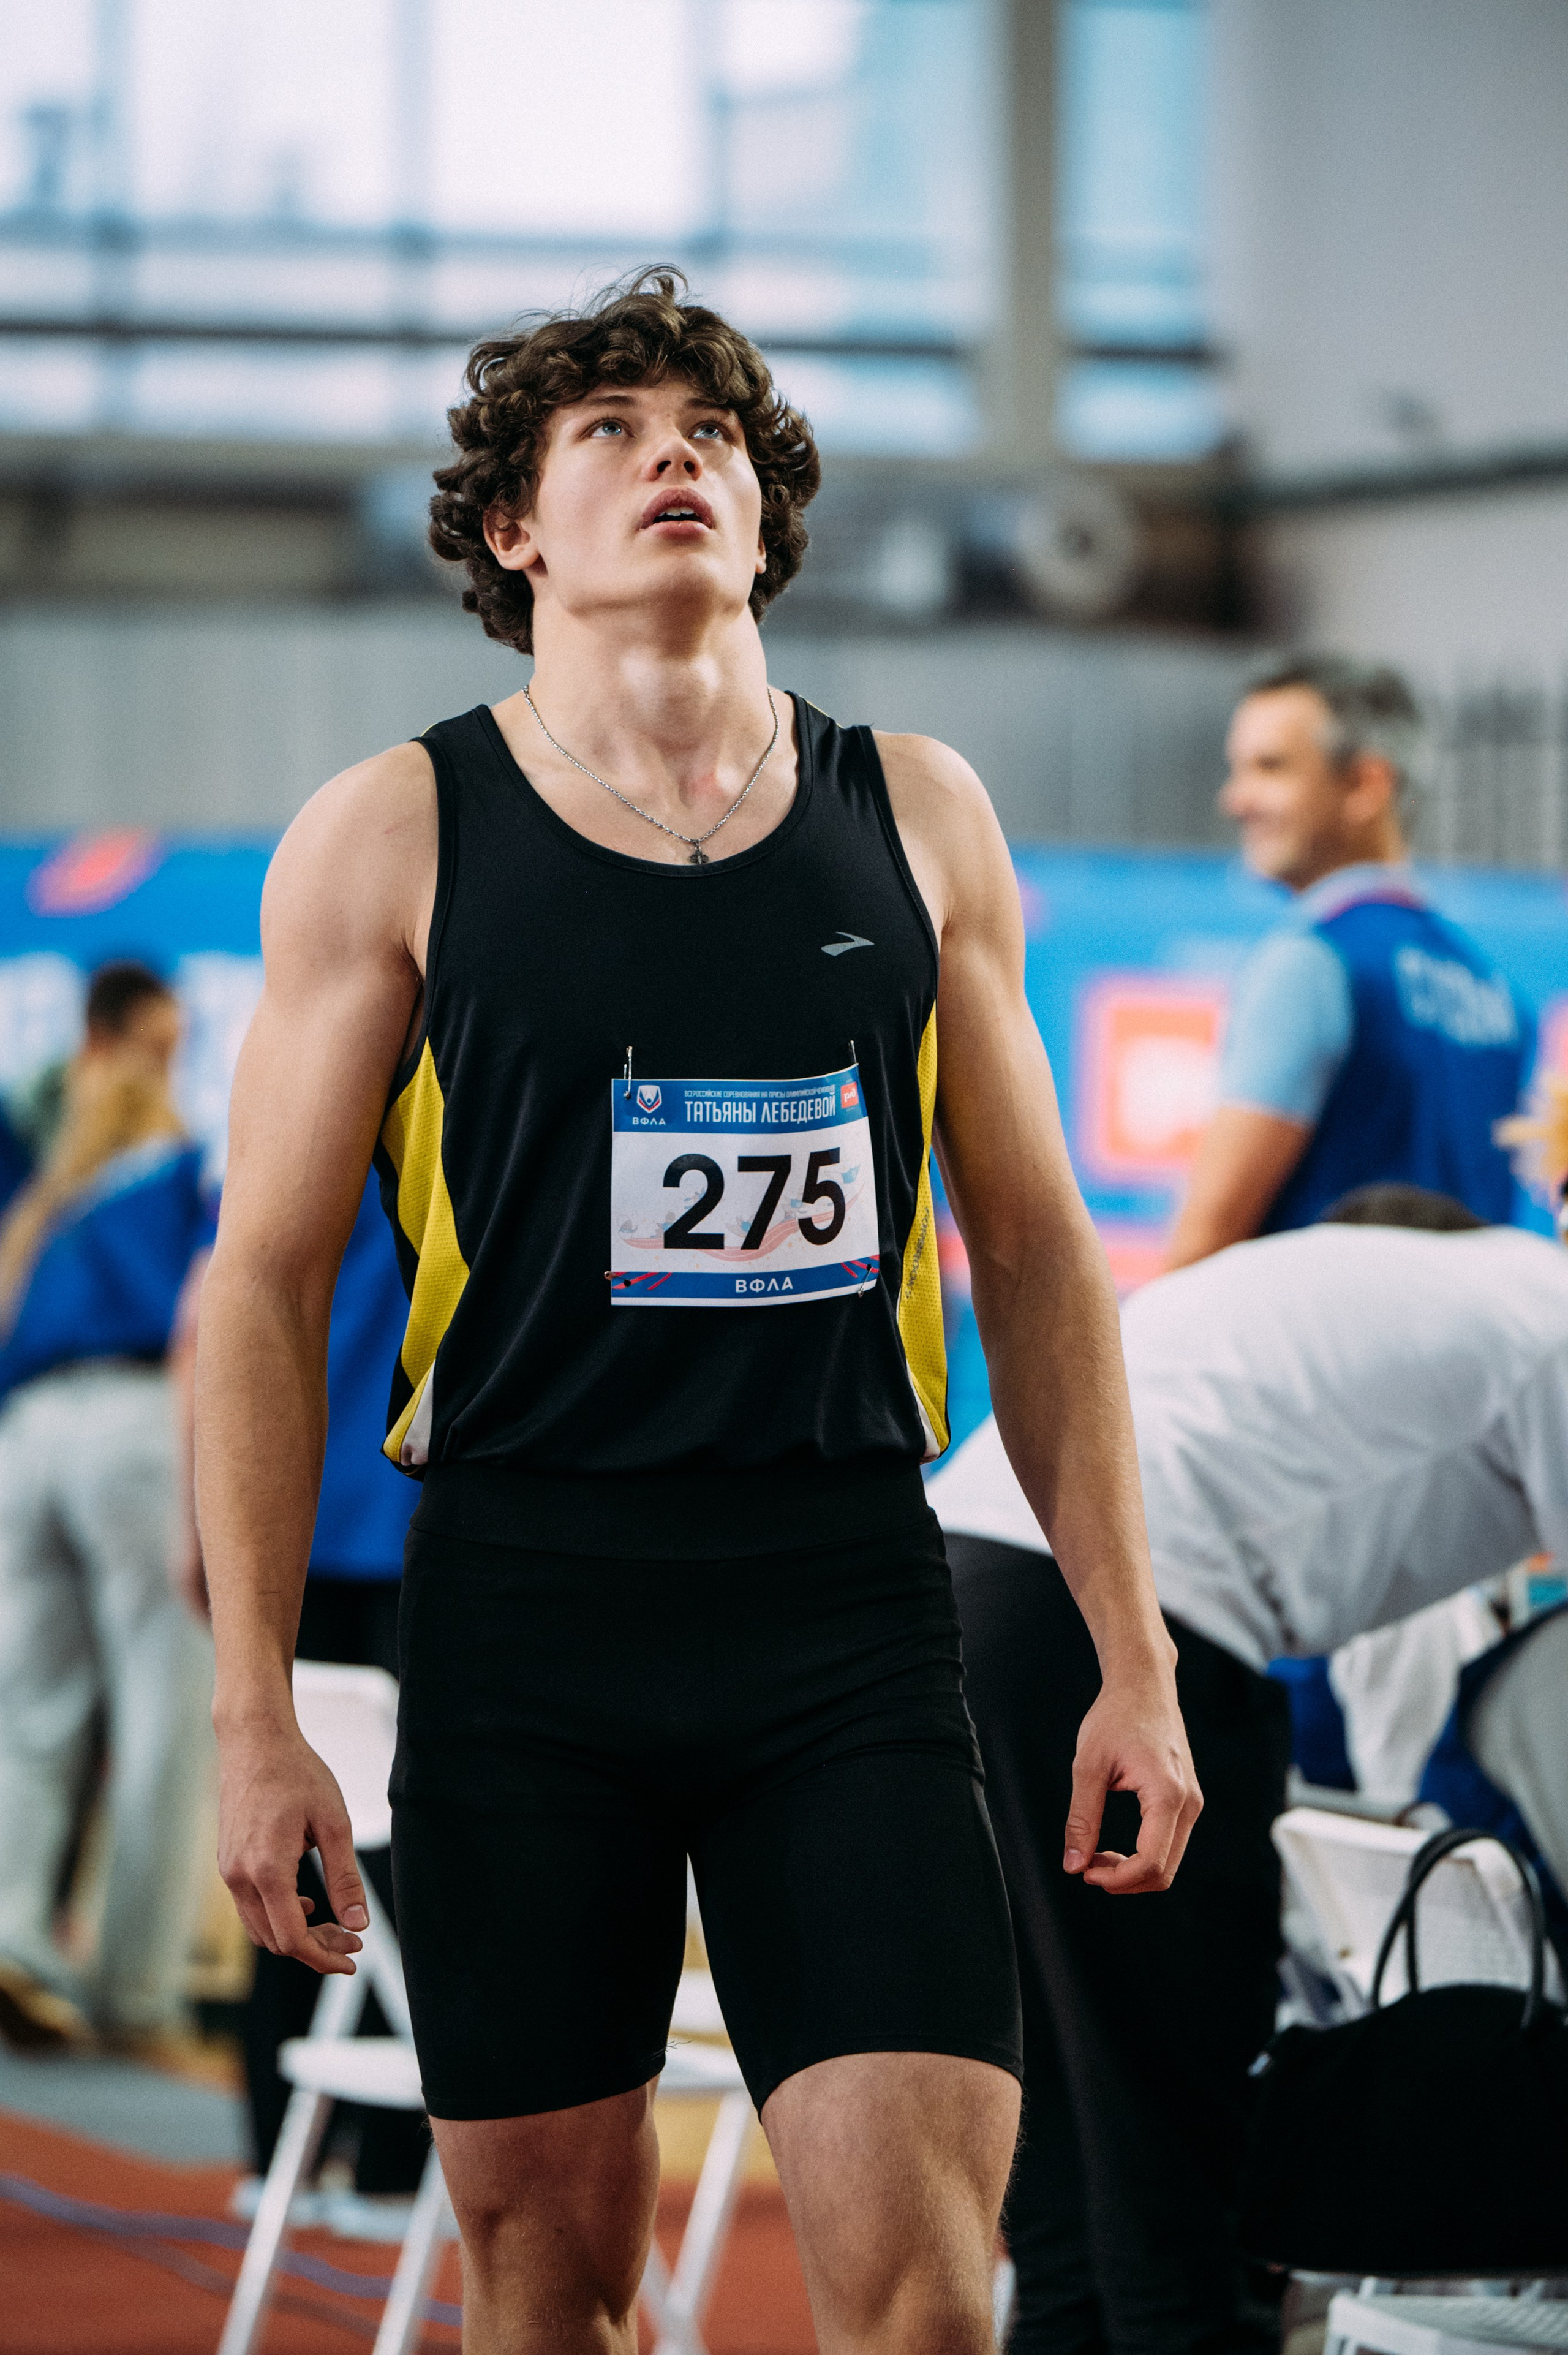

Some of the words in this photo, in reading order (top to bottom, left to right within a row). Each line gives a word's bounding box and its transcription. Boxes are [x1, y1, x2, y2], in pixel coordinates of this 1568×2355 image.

[684, 1100, 756, 1123] ТАТЬЯНЫ
[761, 1091, 836, 1124] ЛЕБЕДЕВОЙ
[632, 1117, 666, 1125] ВФЛА
[663, 1147, 846, 1250] 275
[735, 1276, 794, 1293] ВФЛА
